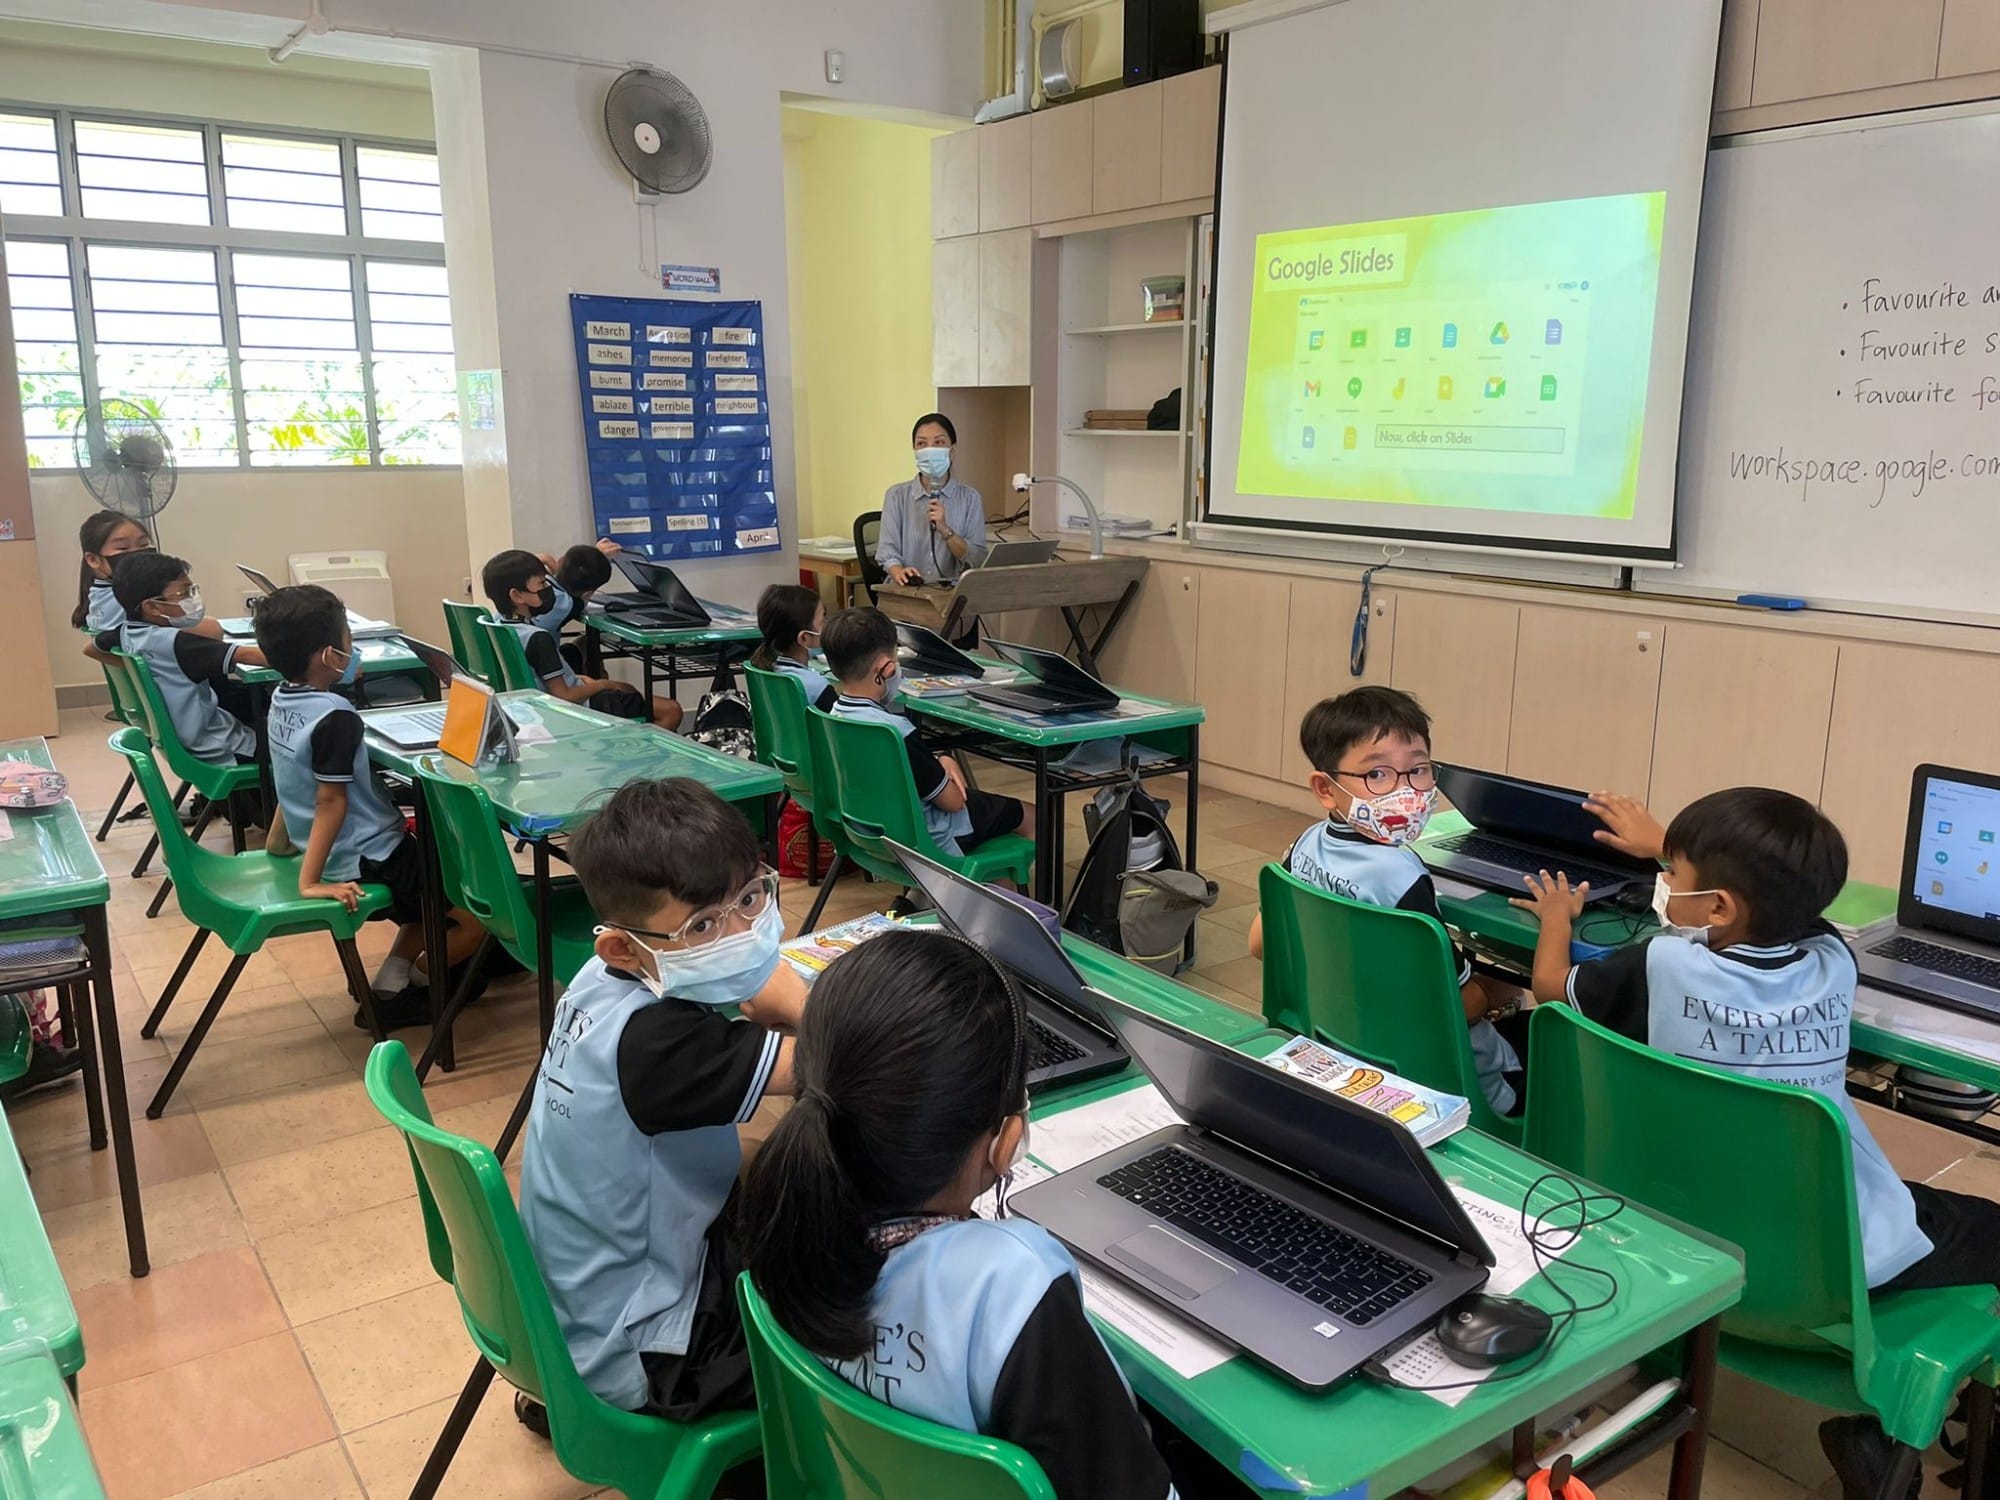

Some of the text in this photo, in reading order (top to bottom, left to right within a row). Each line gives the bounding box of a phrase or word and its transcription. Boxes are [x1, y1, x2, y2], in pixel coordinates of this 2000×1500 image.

[1268, 247, 1394, 281] Google Slides
[1862, 278, 1969, 314] Favourite
[593, 325, 625, 337] March
[725, 330, 740, 341] fire
[1860, 330, 1967, 362] Favourite
[597, 349, 624, 360] ashes
[651, 353, 692, 364] memories
[599, 375, 623, 386] burnt
[646, 377, 684, 388] promise
[1854, 376, 2000, 411] Favourite fo
[600, 400, 628, 410] ablaze
[654, 401, 690, 412] terrible
[603, 425, 635, 437] danger
[1406, 430, 1427, 443] click
[1430, 434, 1442, 443] on
[1445, 431, 1473, 444] Slides
[1682, 993, 1849, 1029] EVERYONE'S
[1699, 1024, 1844, 1055] A TALENT
